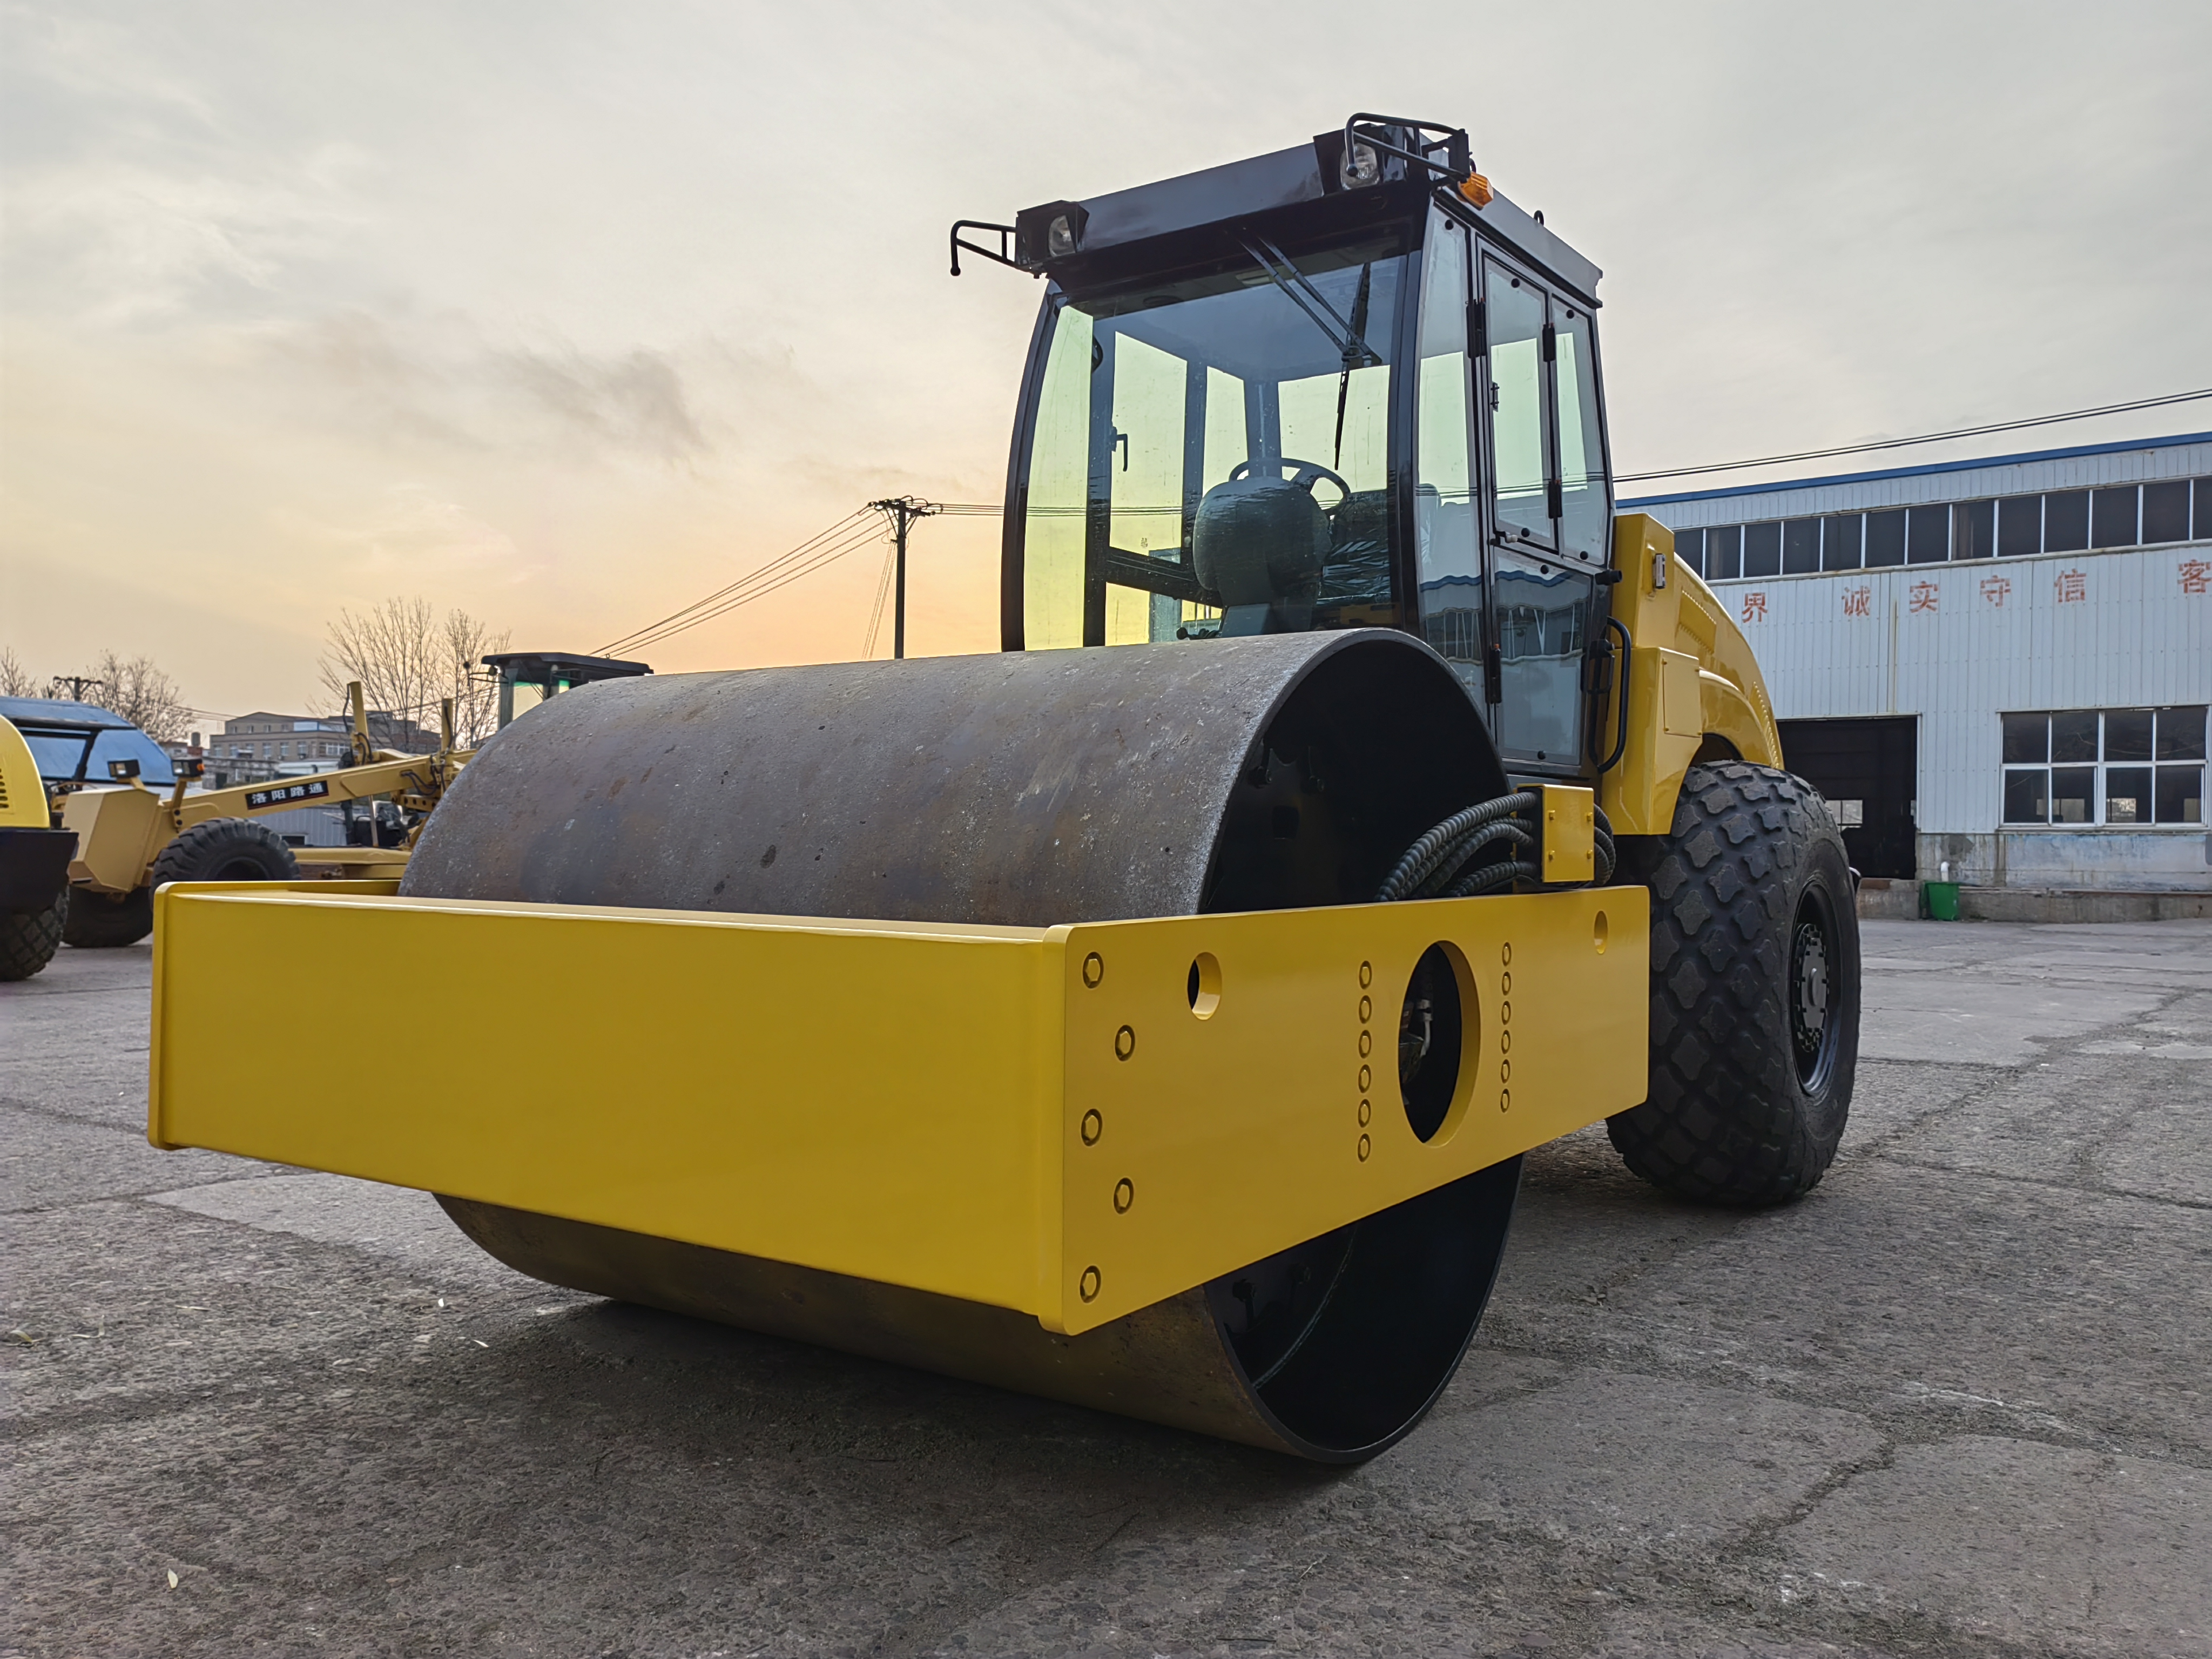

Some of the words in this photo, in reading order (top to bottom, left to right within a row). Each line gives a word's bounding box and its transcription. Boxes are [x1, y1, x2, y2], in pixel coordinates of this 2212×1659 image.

[1742, 592, 1768, 623] 界
[1842, 569, 2087, 617] 诚实守信
[2177, 559, 2212, 594] 客
[252, 783, 323, 804] 洛阳路通
